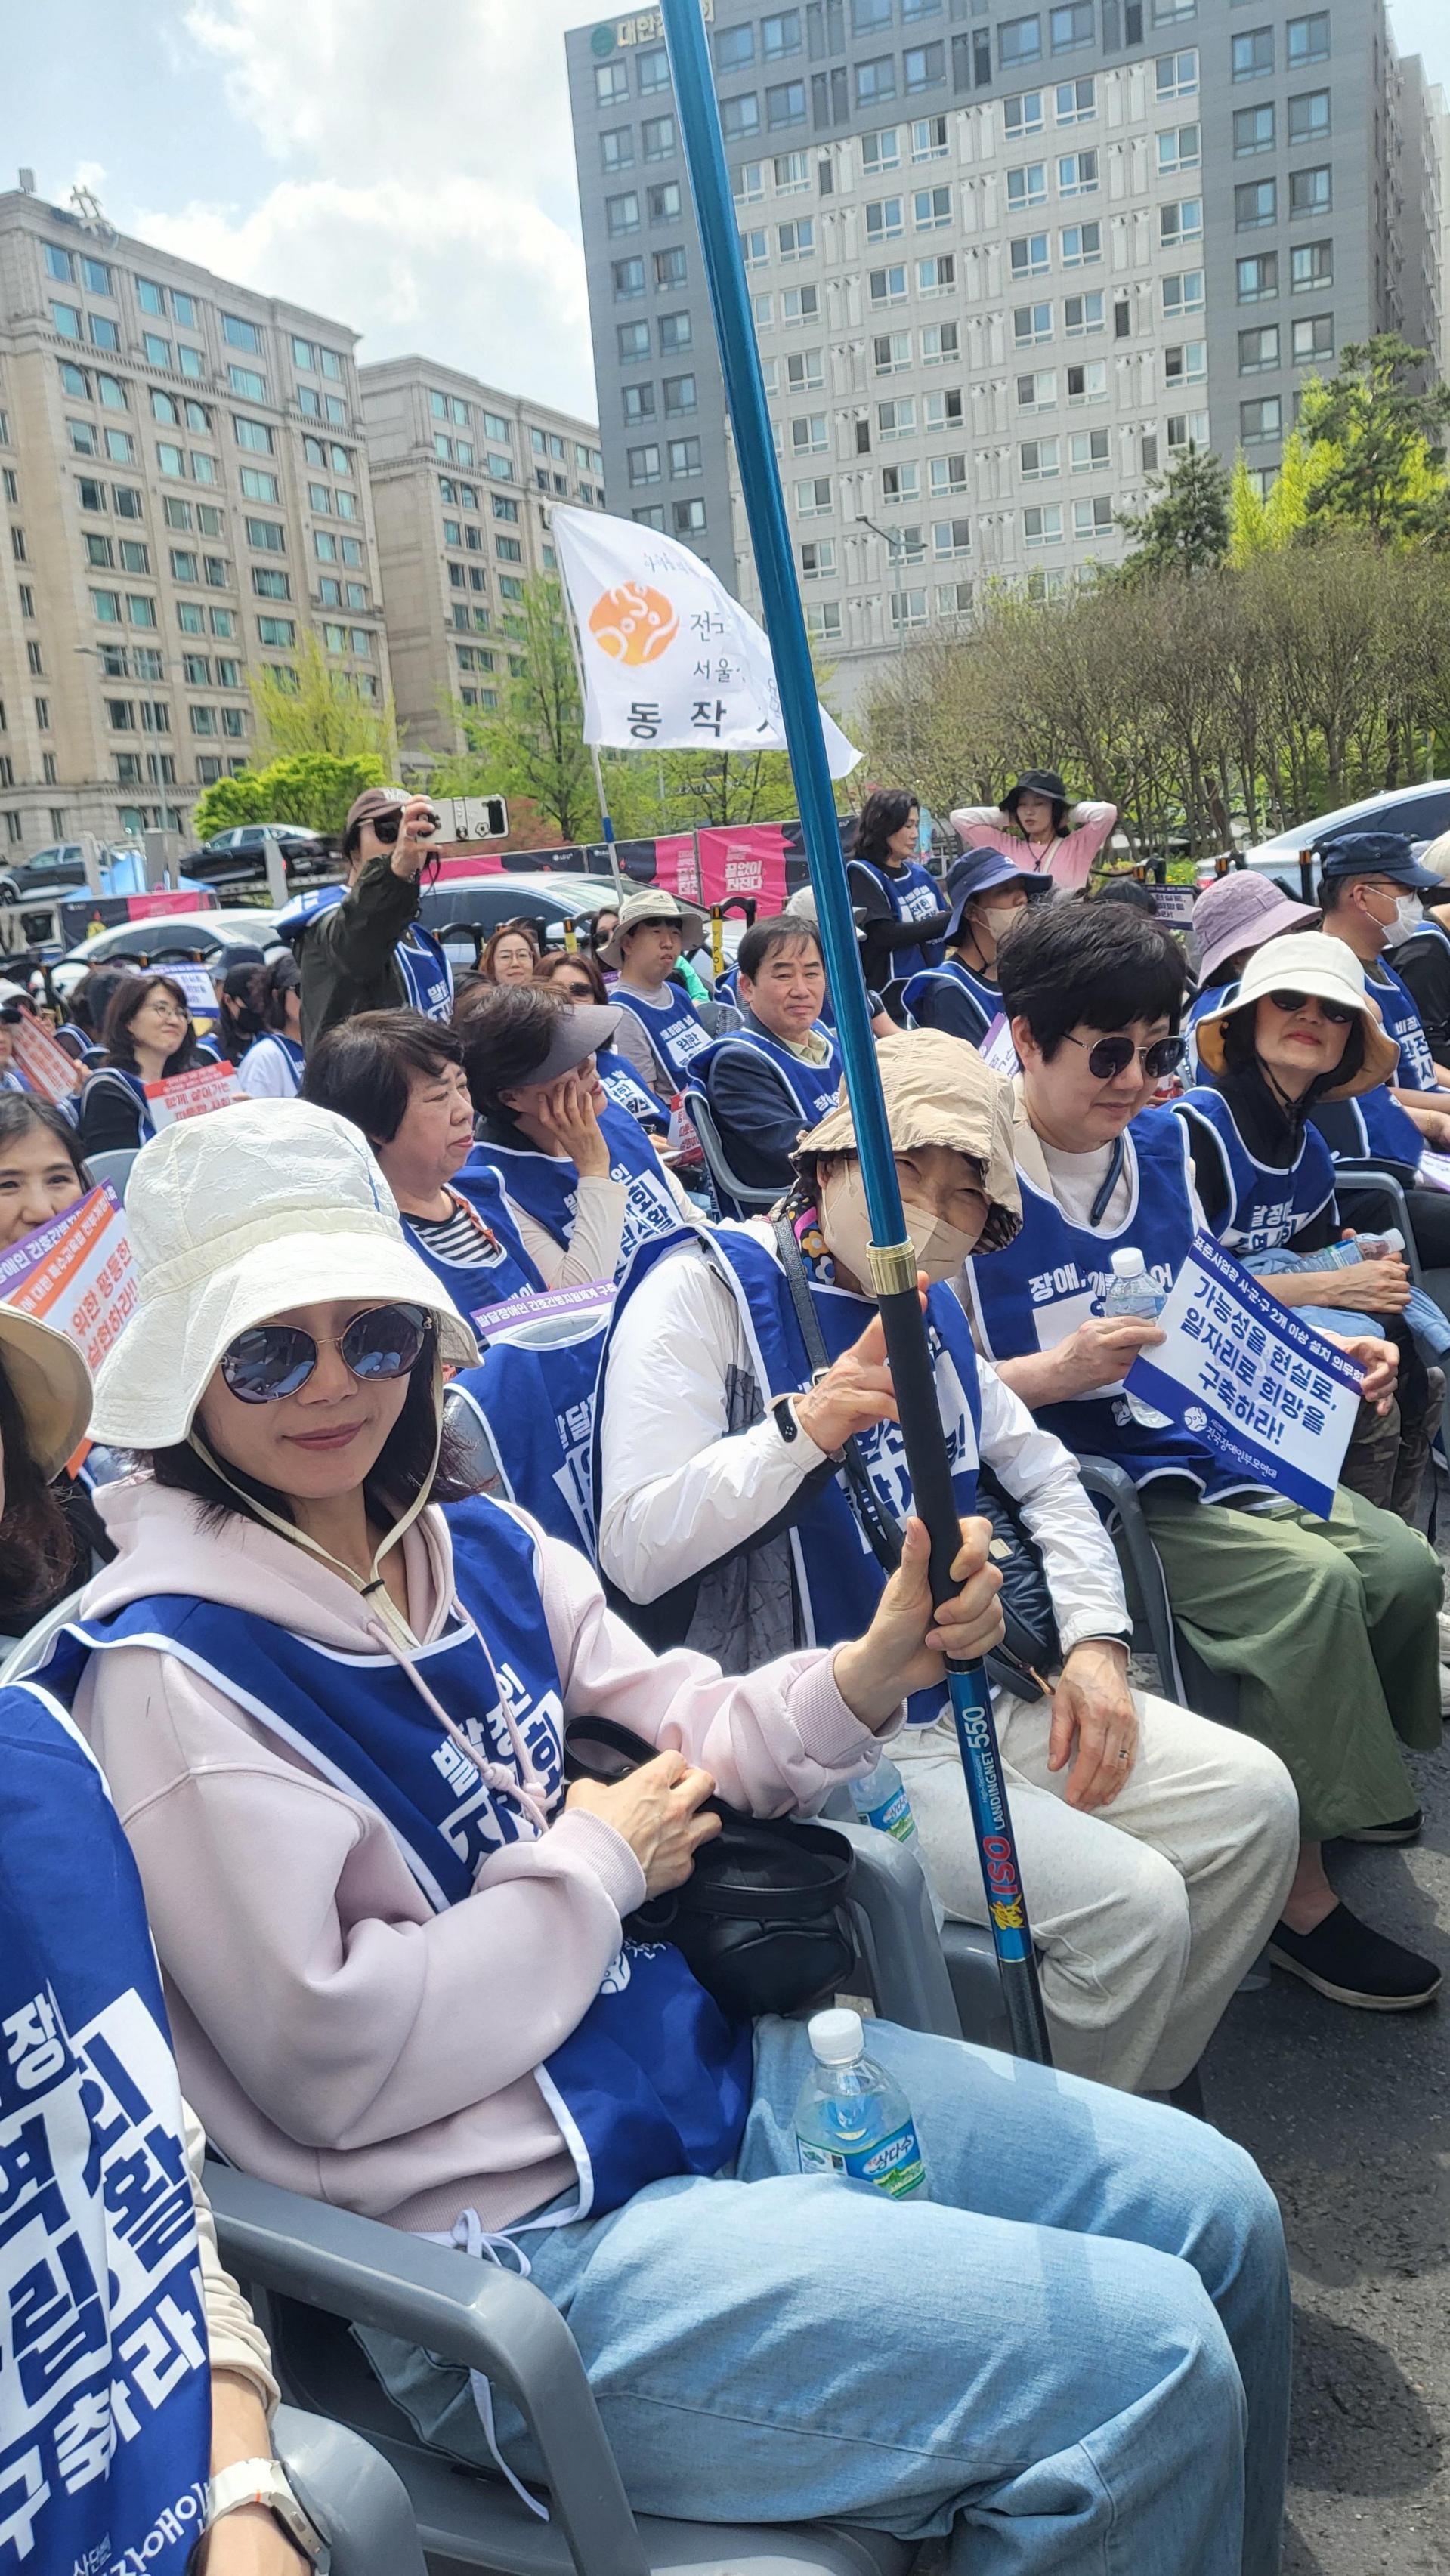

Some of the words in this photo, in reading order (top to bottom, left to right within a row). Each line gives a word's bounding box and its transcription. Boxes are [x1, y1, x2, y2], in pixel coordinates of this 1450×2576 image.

[725, 860, 762, 879] 끝없이
[72, 1289, 101, 1336] 위한
[96, 1236, 134, 1299] 평등한
[475, 1302, 530, 1328] 발달장애인
[529, 1286, 599, 1312] 간호간병지원체계
[1192, 1234, 1240, 1283] 표준사업장
[1269, 1308, 1289, 1330] 2개
[1288, 1324, 1309, 1345] 이상
[1309, 1339, 1331, 1361] 설치
[1331, 1357, 1365, 1382] 의무화
[1180, 1307, 1257, 1388] 일자리로
[1258, 1375, 1326, 1436] 희망을
[1193, 1275, 1267, 1357] 가능성을
[1269, 1344, 1337, 1411] 현실로,
[1198, 1361, 1285, 1446] 구축하라!
[1205, 1425, 1278, 1479] 전국장애인부모연대
[962, 1706, 991, 1749] 550
[981, 1751, 1006, 1831] LANDINGNET
[983, 1836, 1019, 1895] ISO
[870, 2134, 913, 2173] 삼다수
